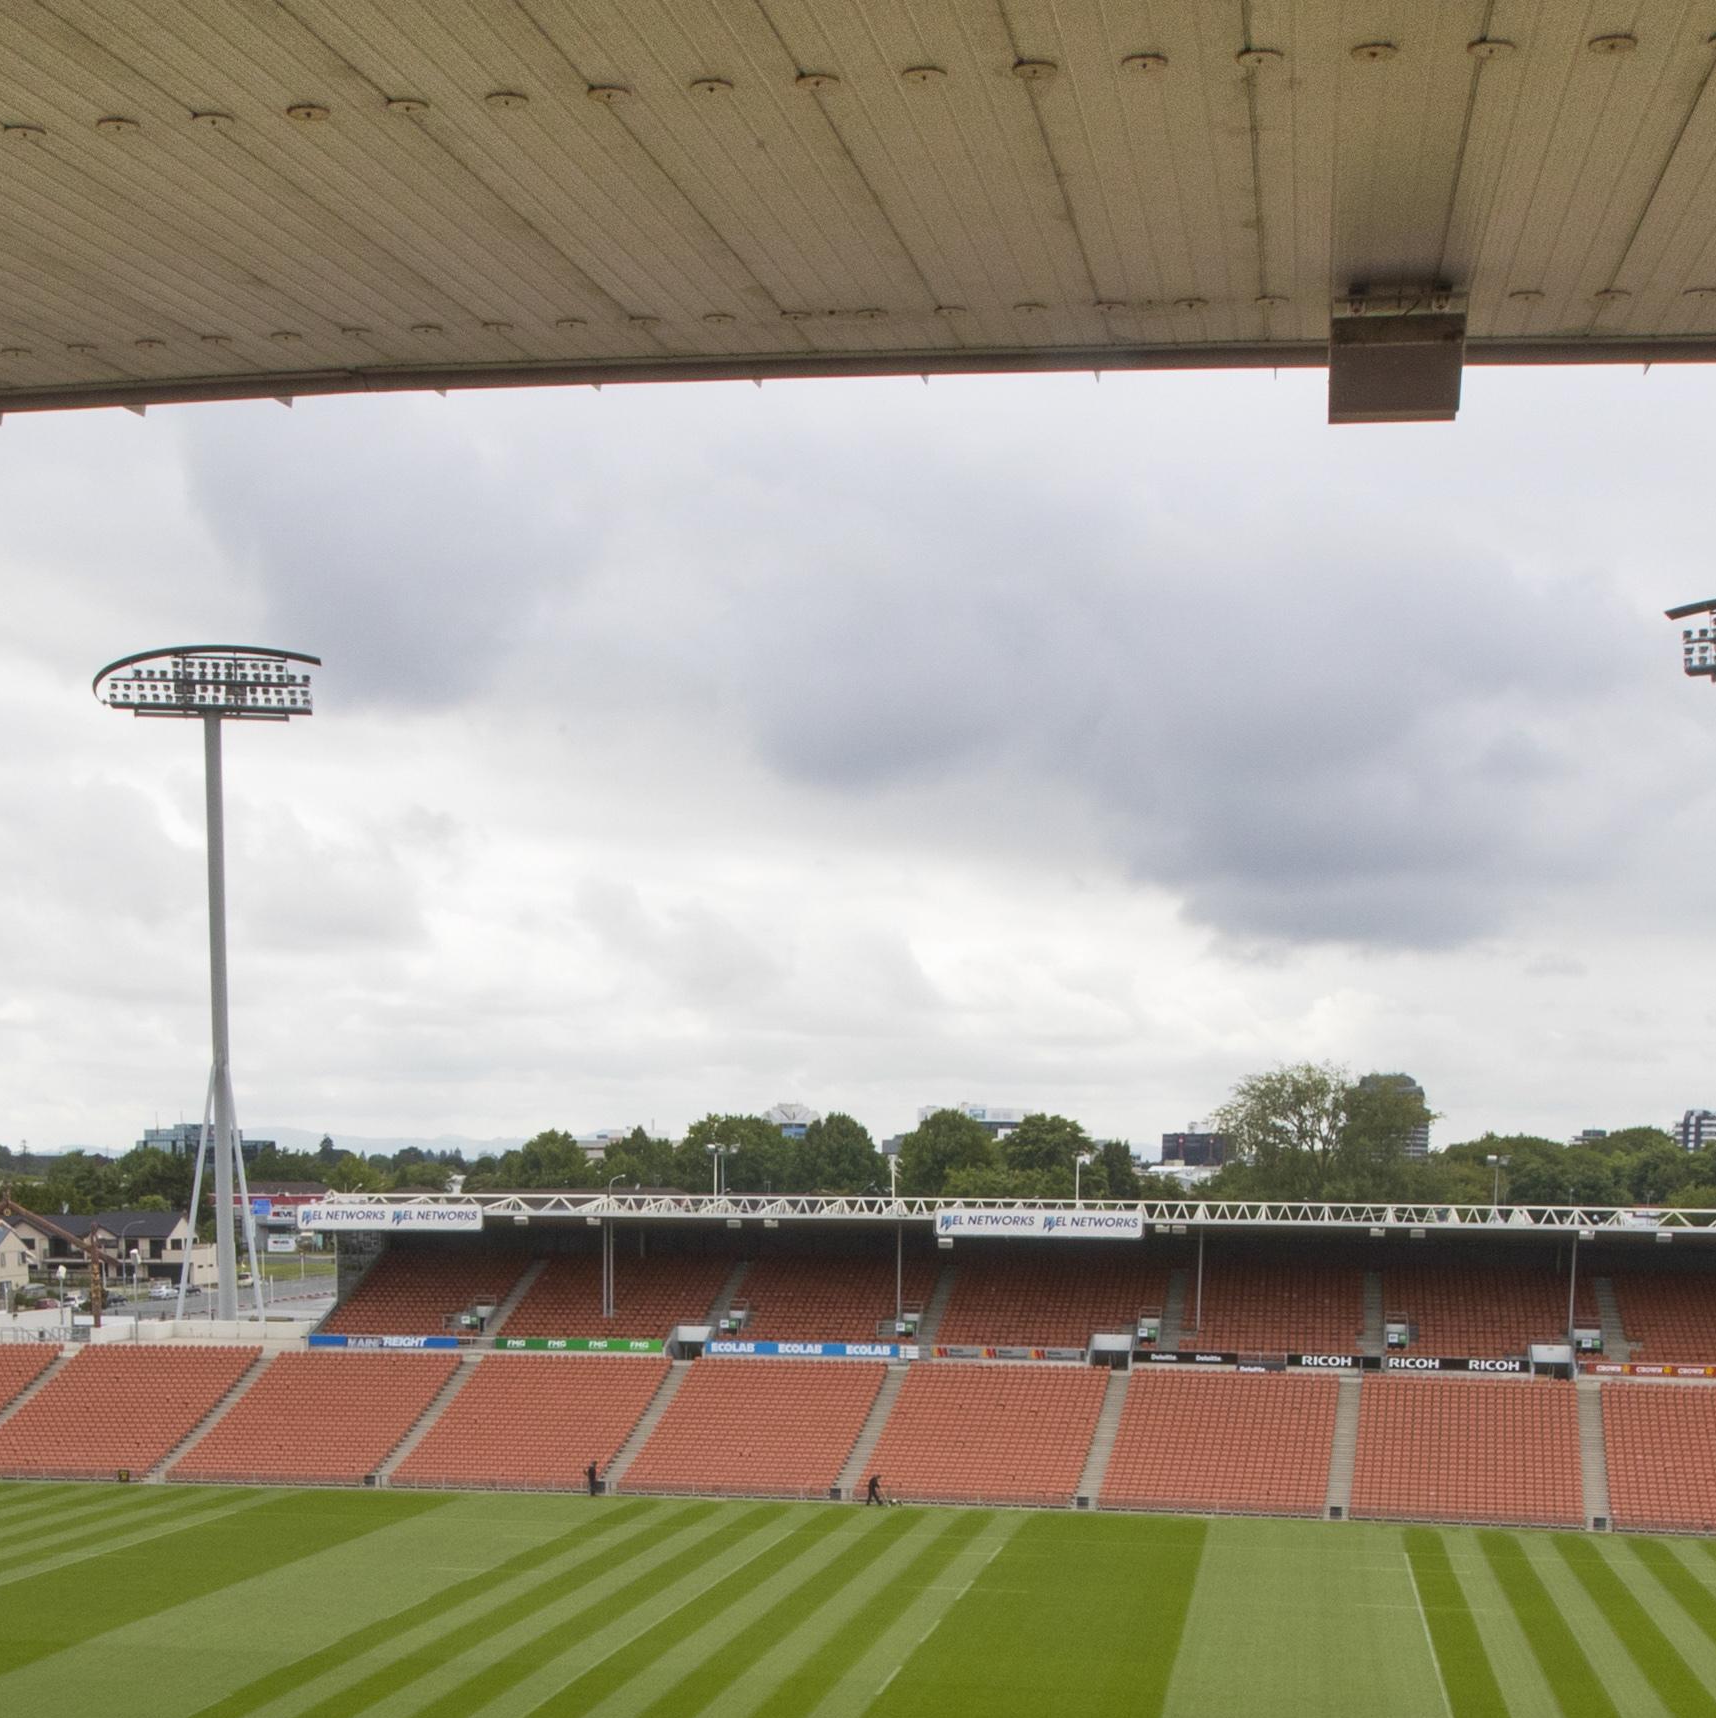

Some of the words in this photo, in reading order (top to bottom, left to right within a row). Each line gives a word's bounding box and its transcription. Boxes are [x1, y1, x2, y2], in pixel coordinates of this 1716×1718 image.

[325, 1210, 386, 1221] NETWORKS
[416, 1211, 477, 1222] NETWORKS
[967, 1215, 1035, 1226] NETWORKS
[1071, 1216, 1138, 1229] NETWORKS
[506, 1339, 526, 1348] FMG
[548, 1339, 566, 1348] FMG
[588, 1340, 608, 1348] FMG
[630, 1341, 649, 1349] FMG
[710, 1342, 755, 1353] ECOLAB
[778, 1343, 823, 1354] ECOLAB
[846, 1345, 891, 1355] ECOLAB
[1301, 1355, 1352, 1367] RICOH
[1388, 1357, 1440, 1369] RICOH
[1468, 1359, 1520, 1371] RICOH
